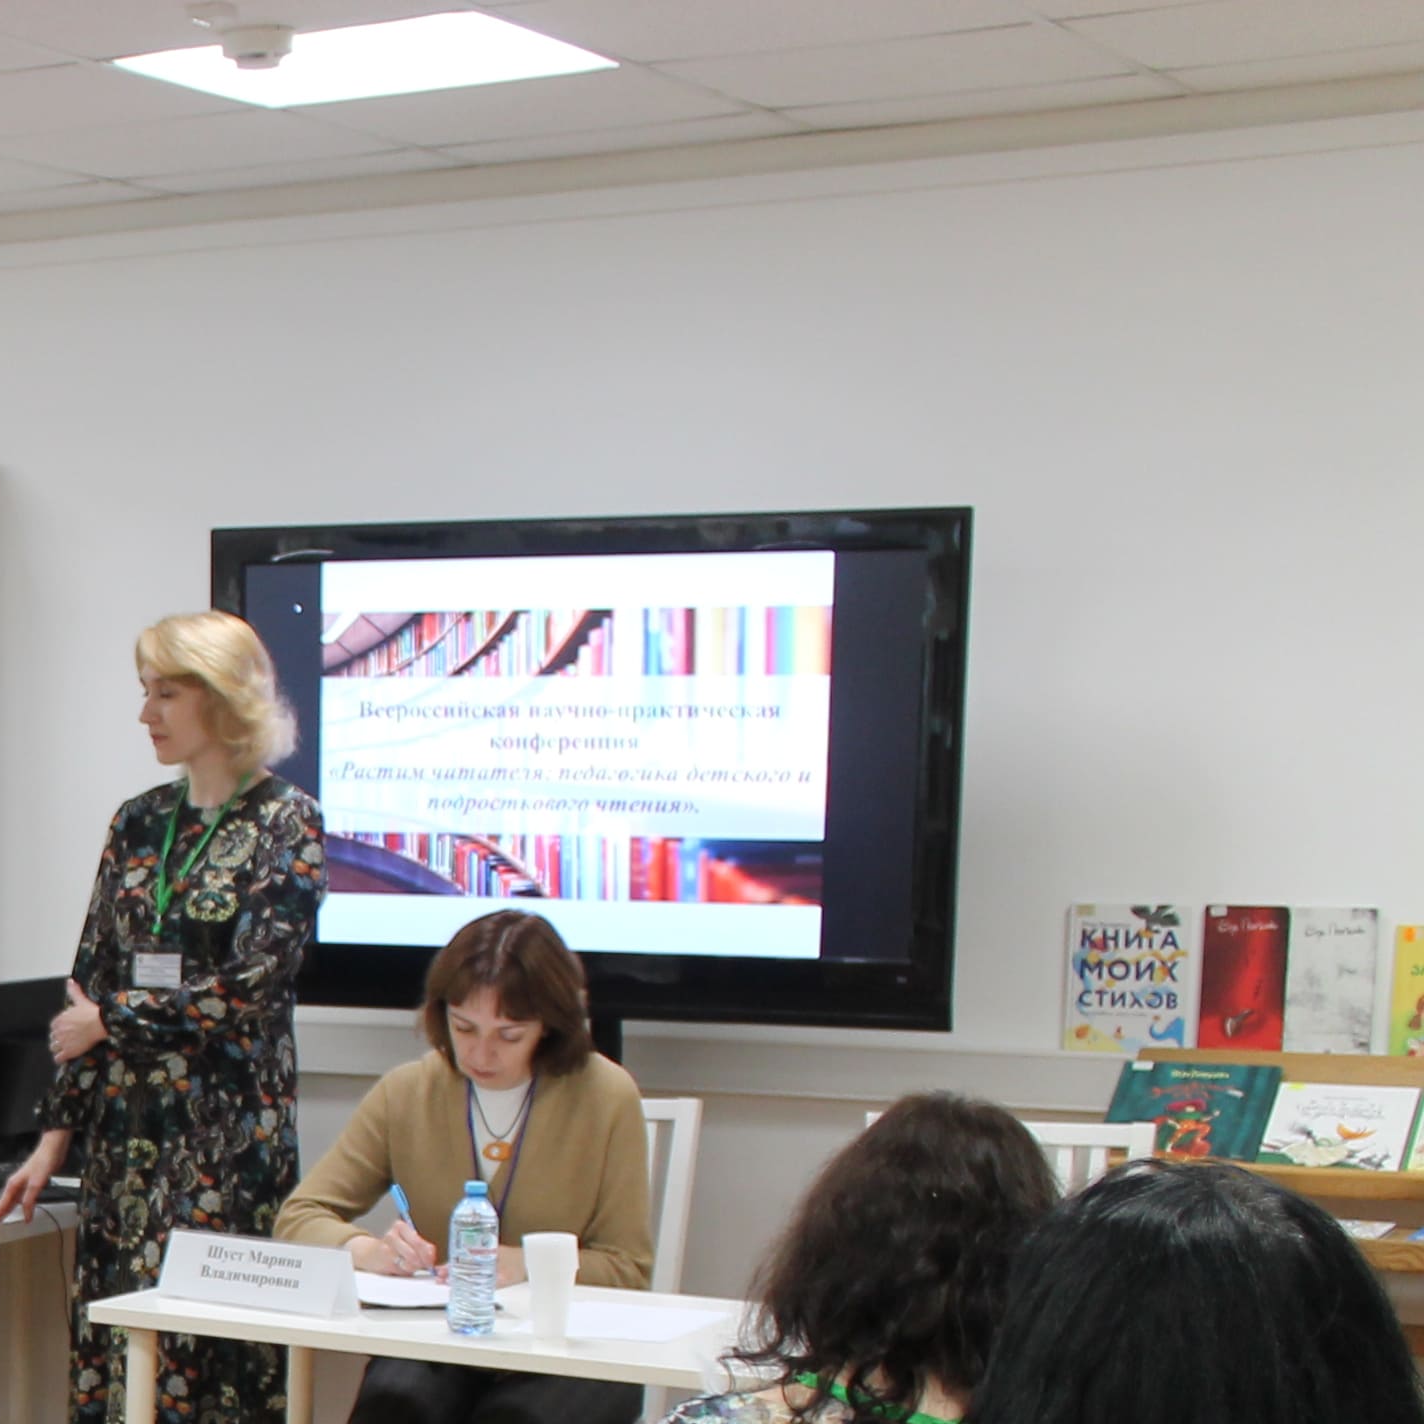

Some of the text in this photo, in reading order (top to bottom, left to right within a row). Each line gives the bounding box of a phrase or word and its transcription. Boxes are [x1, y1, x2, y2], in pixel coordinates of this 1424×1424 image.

[359, 701, 782, 723] Всероссийская научно-практическая
[490, 733, 639, 754] конференция
[329, 761, 425, 781] «Растим
[558, 765, 678, 782] педагогика
[686, 765, 791, 783] детского
[797, 771, 812, 783] и
[427, 794, 590, 815] подросткового
[1081, 928, 1180, 950] КНИГА
[1079, 959, 1179, 982] МОИХ
[1078, 990, 1179, 1010] СТИХОВ
[207, 1244, 303, 1269] Шуст Марина
[200, 1264, 300, 1289] Владимировна
